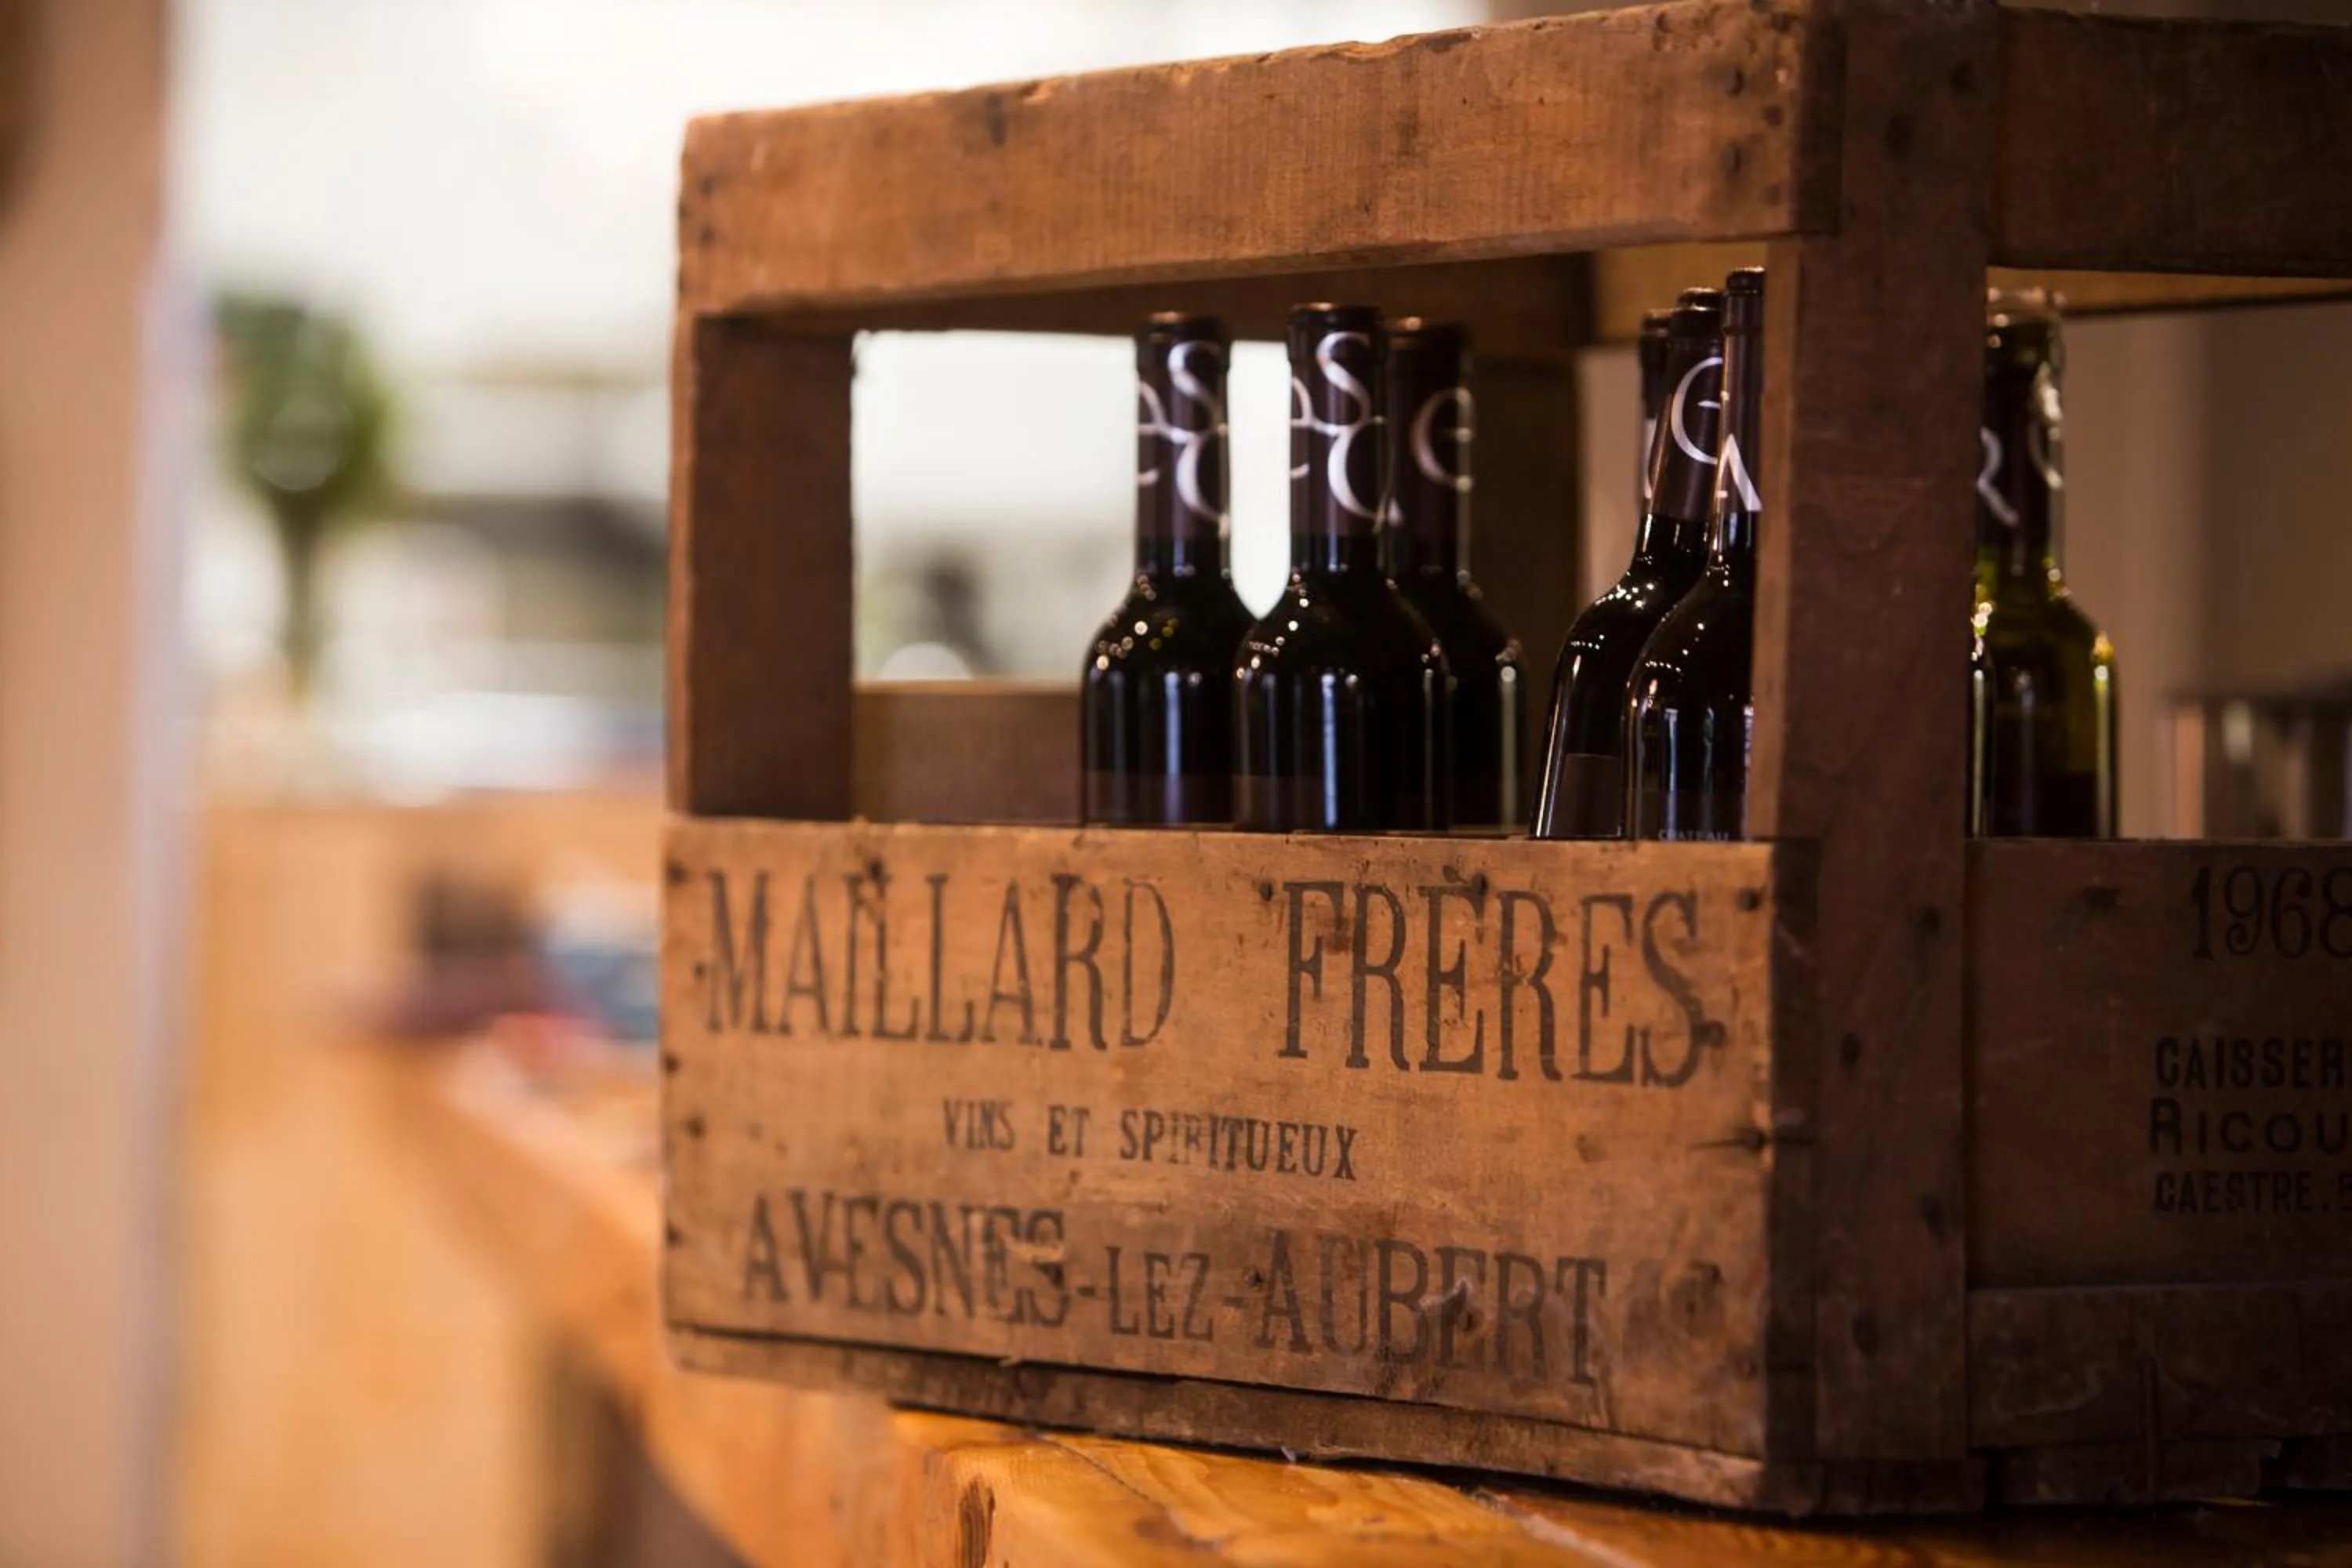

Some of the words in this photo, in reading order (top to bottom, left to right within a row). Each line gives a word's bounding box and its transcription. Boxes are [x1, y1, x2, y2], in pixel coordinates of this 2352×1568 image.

[2191, 865, 2352, 961] 1968
[706, 869, 1175, 1051] MAILLARD
[2155, 1036, 2345, 1090] CAISSER
[943, 1099, 1016, 1151] VINS
[1047, 1104, 1091, 1157] ET
[1119, 1108, 1358, 1181] SPIRITUEUX
